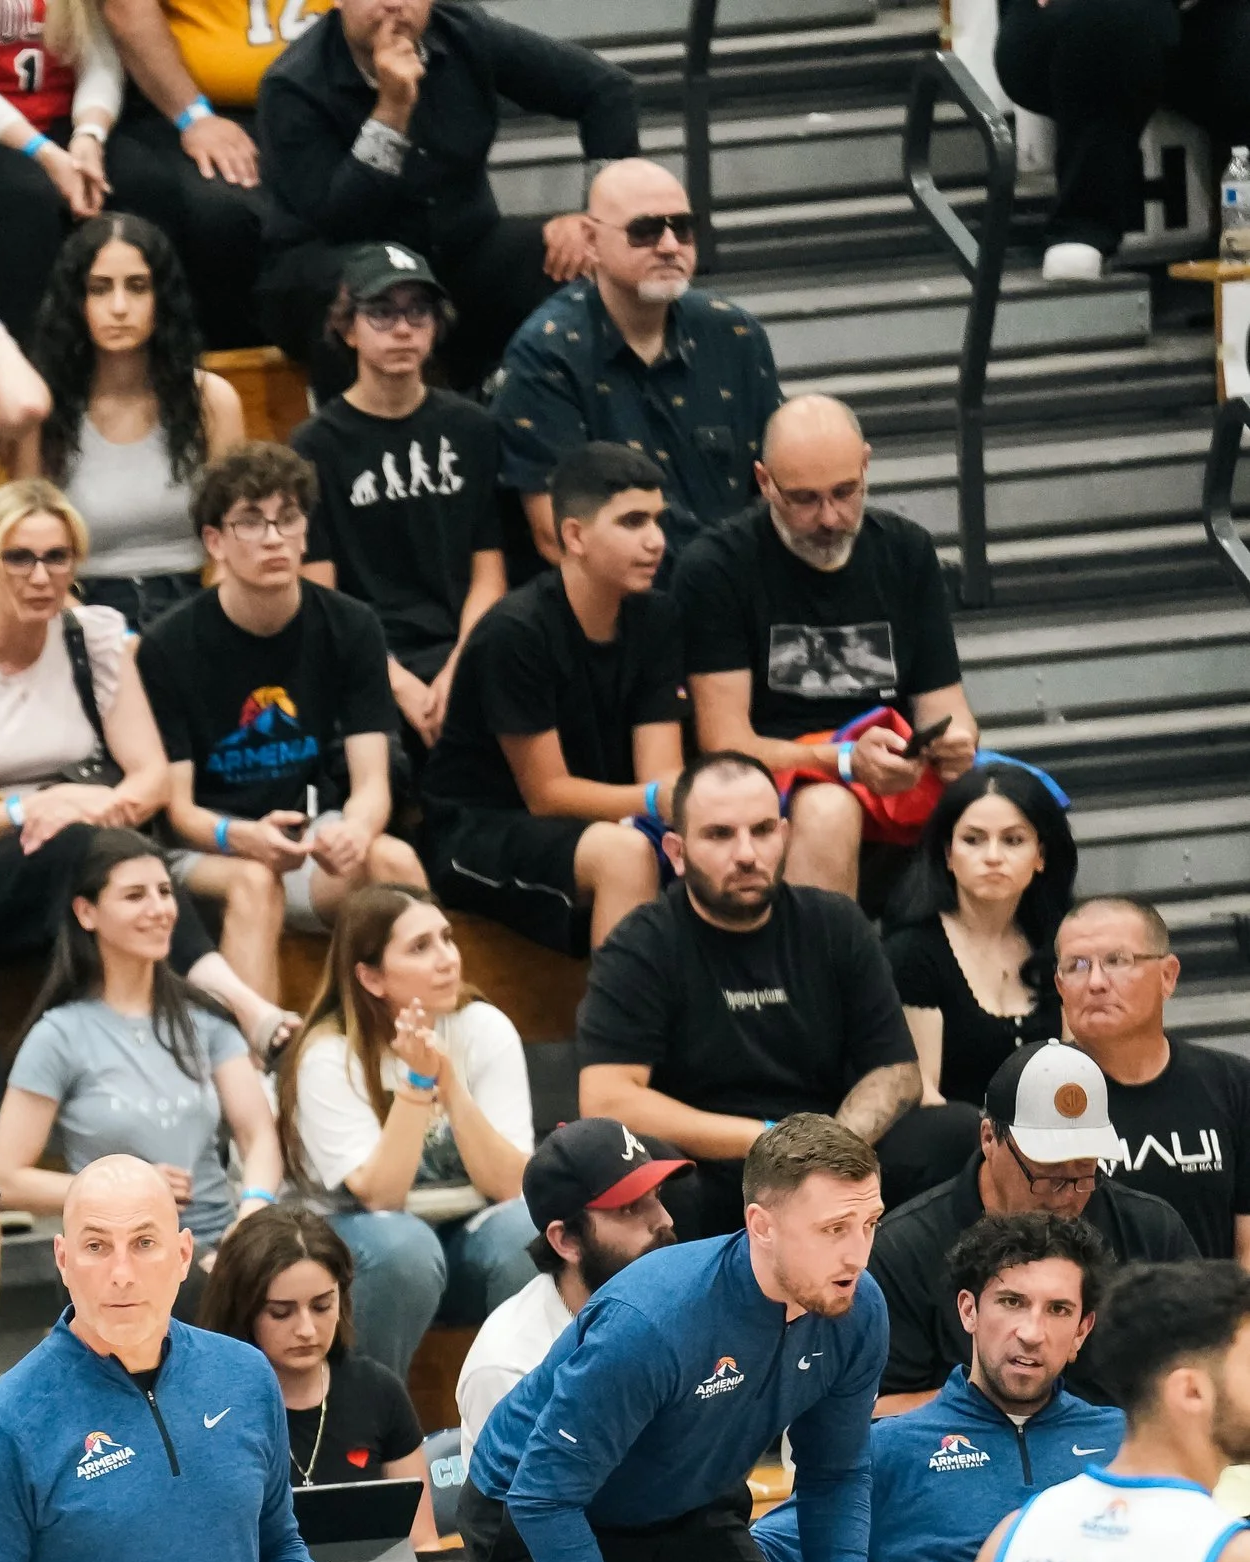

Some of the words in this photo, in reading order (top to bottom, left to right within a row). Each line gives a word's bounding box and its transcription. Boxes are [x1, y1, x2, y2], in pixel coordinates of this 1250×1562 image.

[77, 1446, 136, 1478] ARMENIA
[85, 1459, 132, 1481] BASKETBALL
[929, 1451, 991, 1469] ARMENIA
